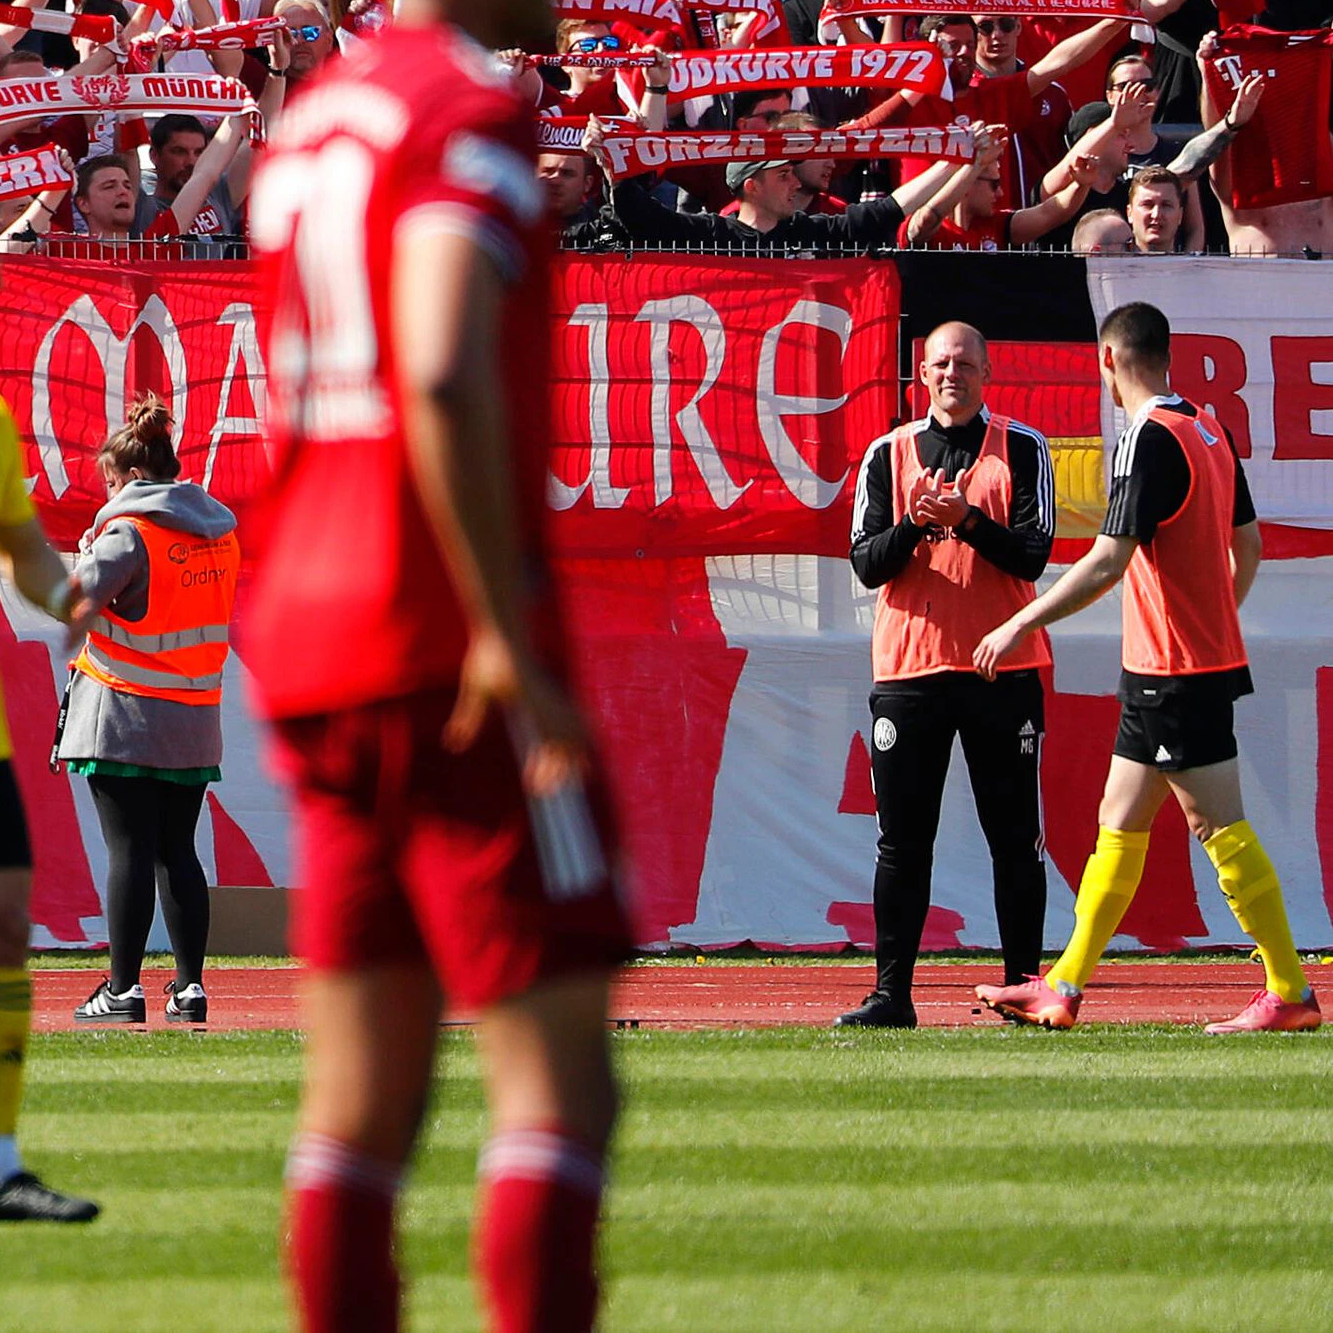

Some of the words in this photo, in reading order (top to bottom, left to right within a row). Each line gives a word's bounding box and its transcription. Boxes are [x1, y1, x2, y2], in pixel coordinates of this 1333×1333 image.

[851, 48, 932, 83] 1972
[84, 83, 118, 95] 1972
[606, 132, 766, 174] FORZA
[781, 125, 977, 159] BAYERN
